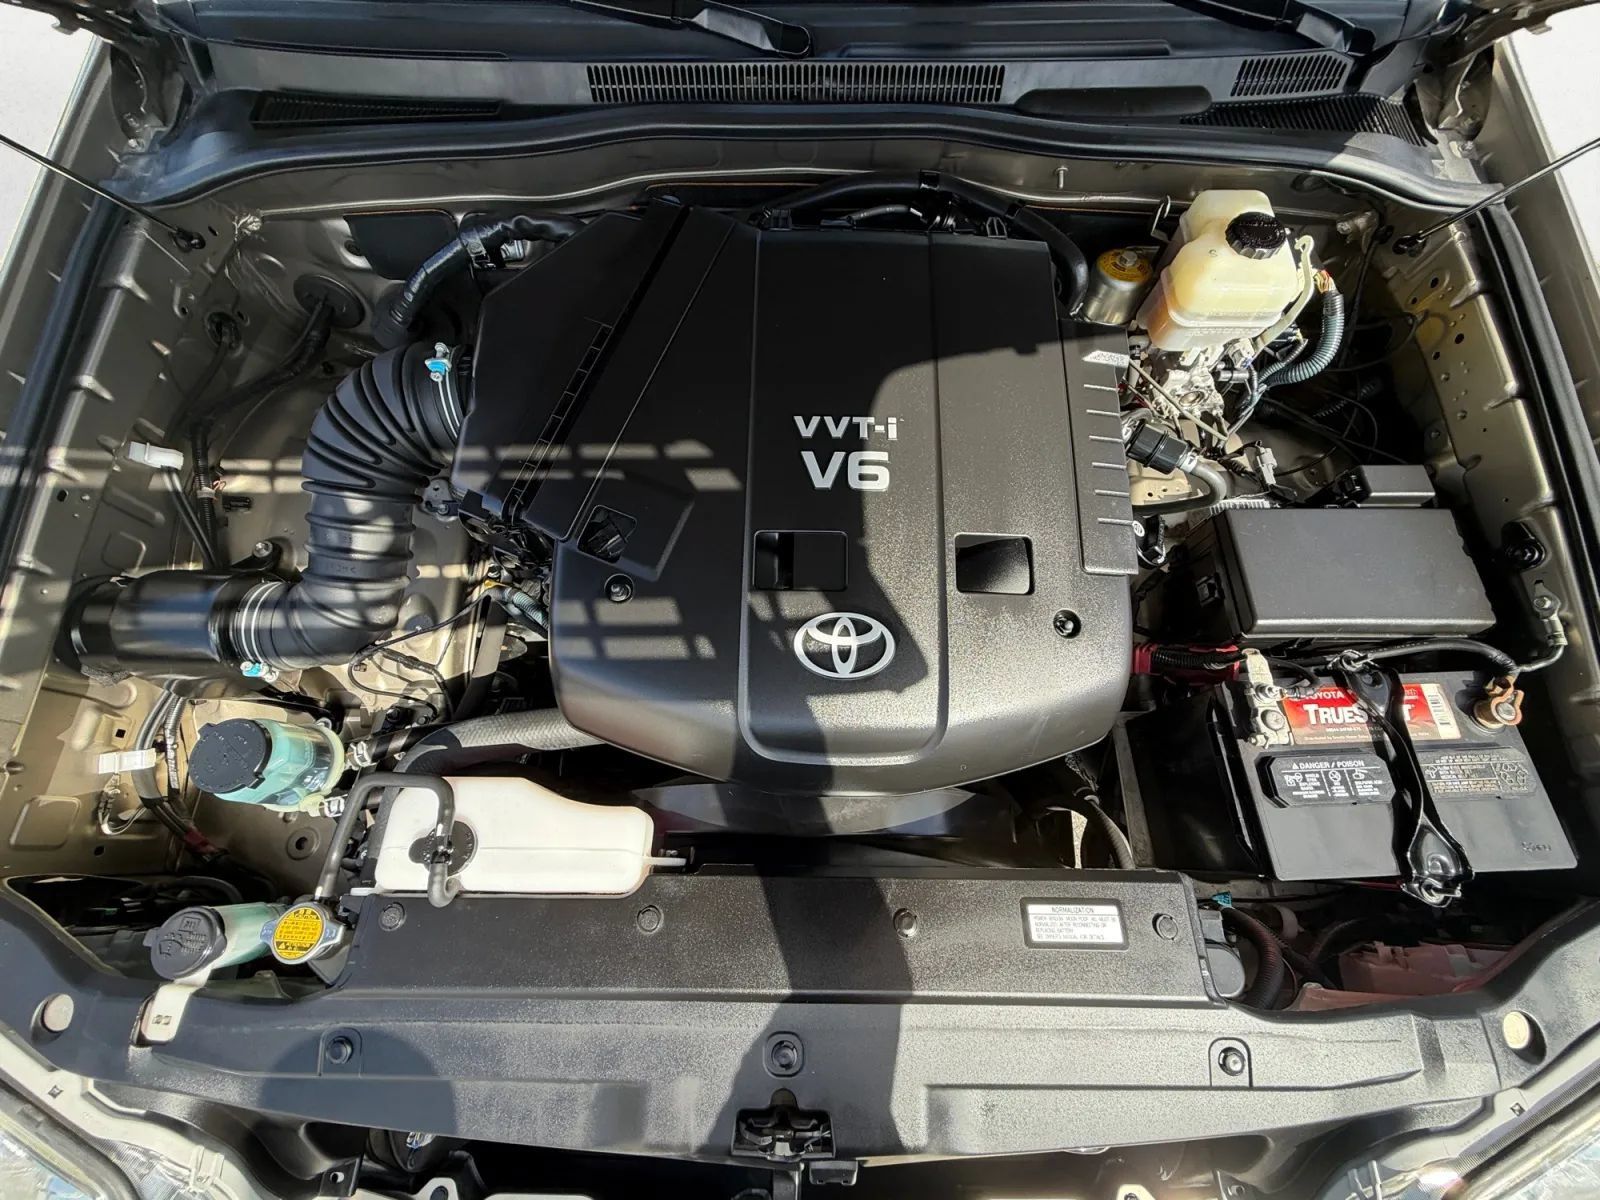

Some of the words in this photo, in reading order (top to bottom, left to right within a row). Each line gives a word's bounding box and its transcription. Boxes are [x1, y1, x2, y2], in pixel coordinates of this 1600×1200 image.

[793, 415, 897, 440] VVT-i
[800, 450, 890, 491] V6
[1303, 702, 1413, 725] TRUEST
[1299, 761, 1330, 769] DANGER
[1337, 760, 1365, 768] POISON
[1051, 906, 1095, 914] NORMALIZATION
